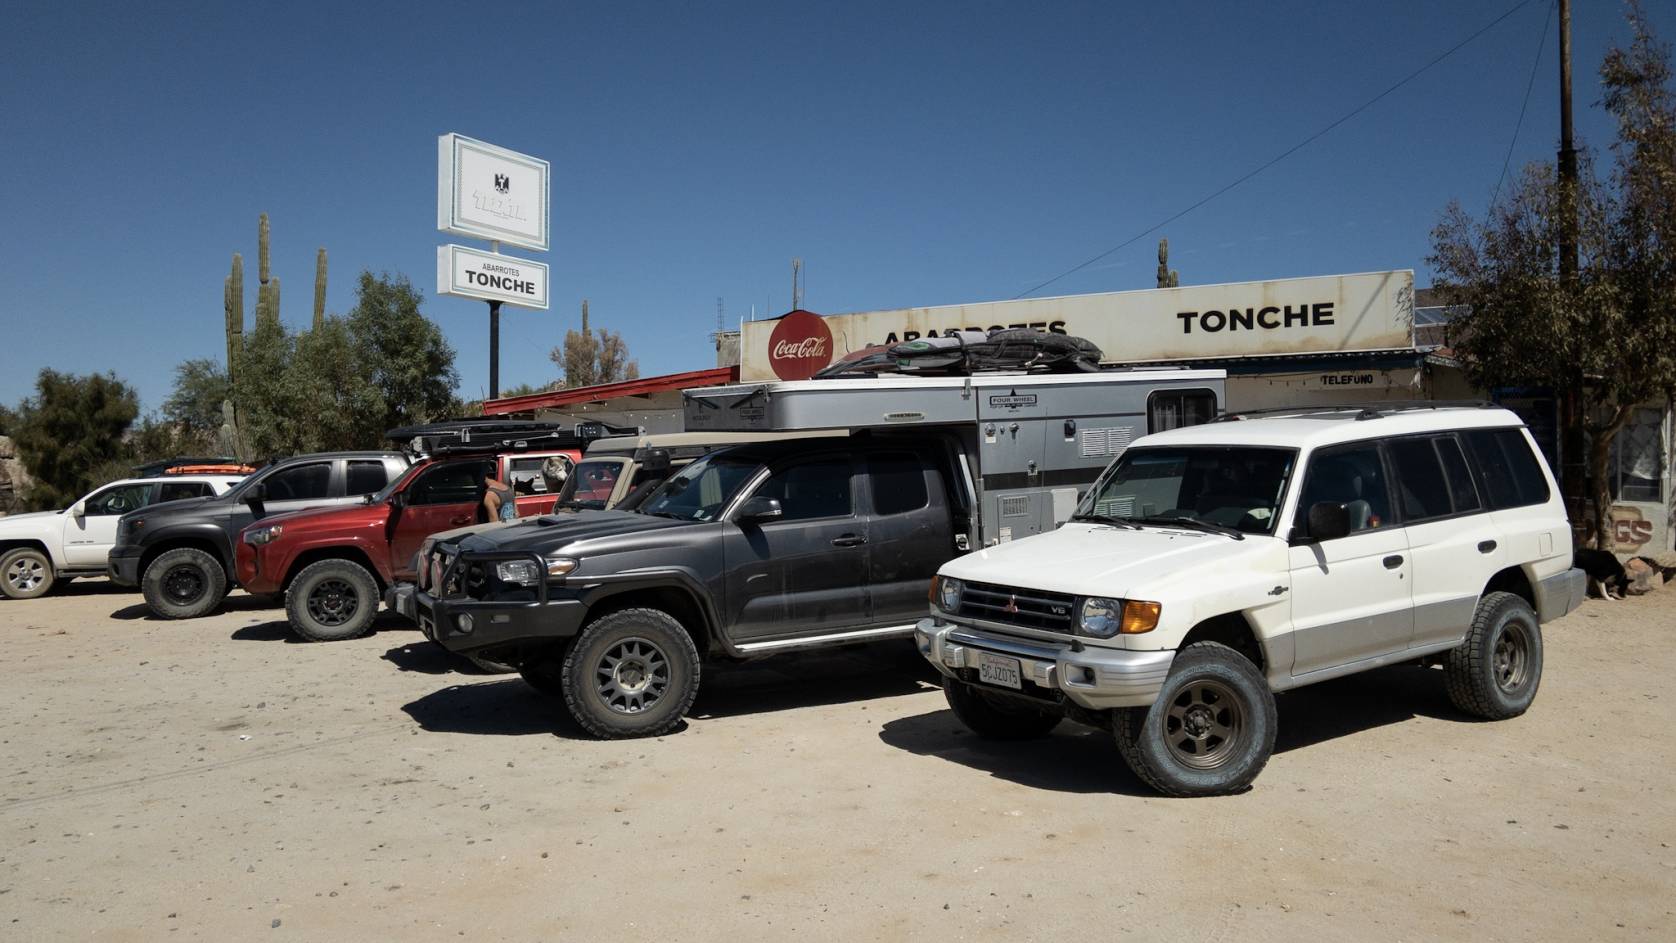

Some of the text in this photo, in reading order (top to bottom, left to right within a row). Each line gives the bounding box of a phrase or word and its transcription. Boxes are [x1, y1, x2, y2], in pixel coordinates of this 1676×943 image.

[482, 263, 520, 277] ABARROTES
[465, 269, 535, 295] TONCHE
[1176, 302, 1335, 334] TONCHE
[773, 337, 826, 359] Coca-Cola
[1051, 606, 1065, 614] V6
